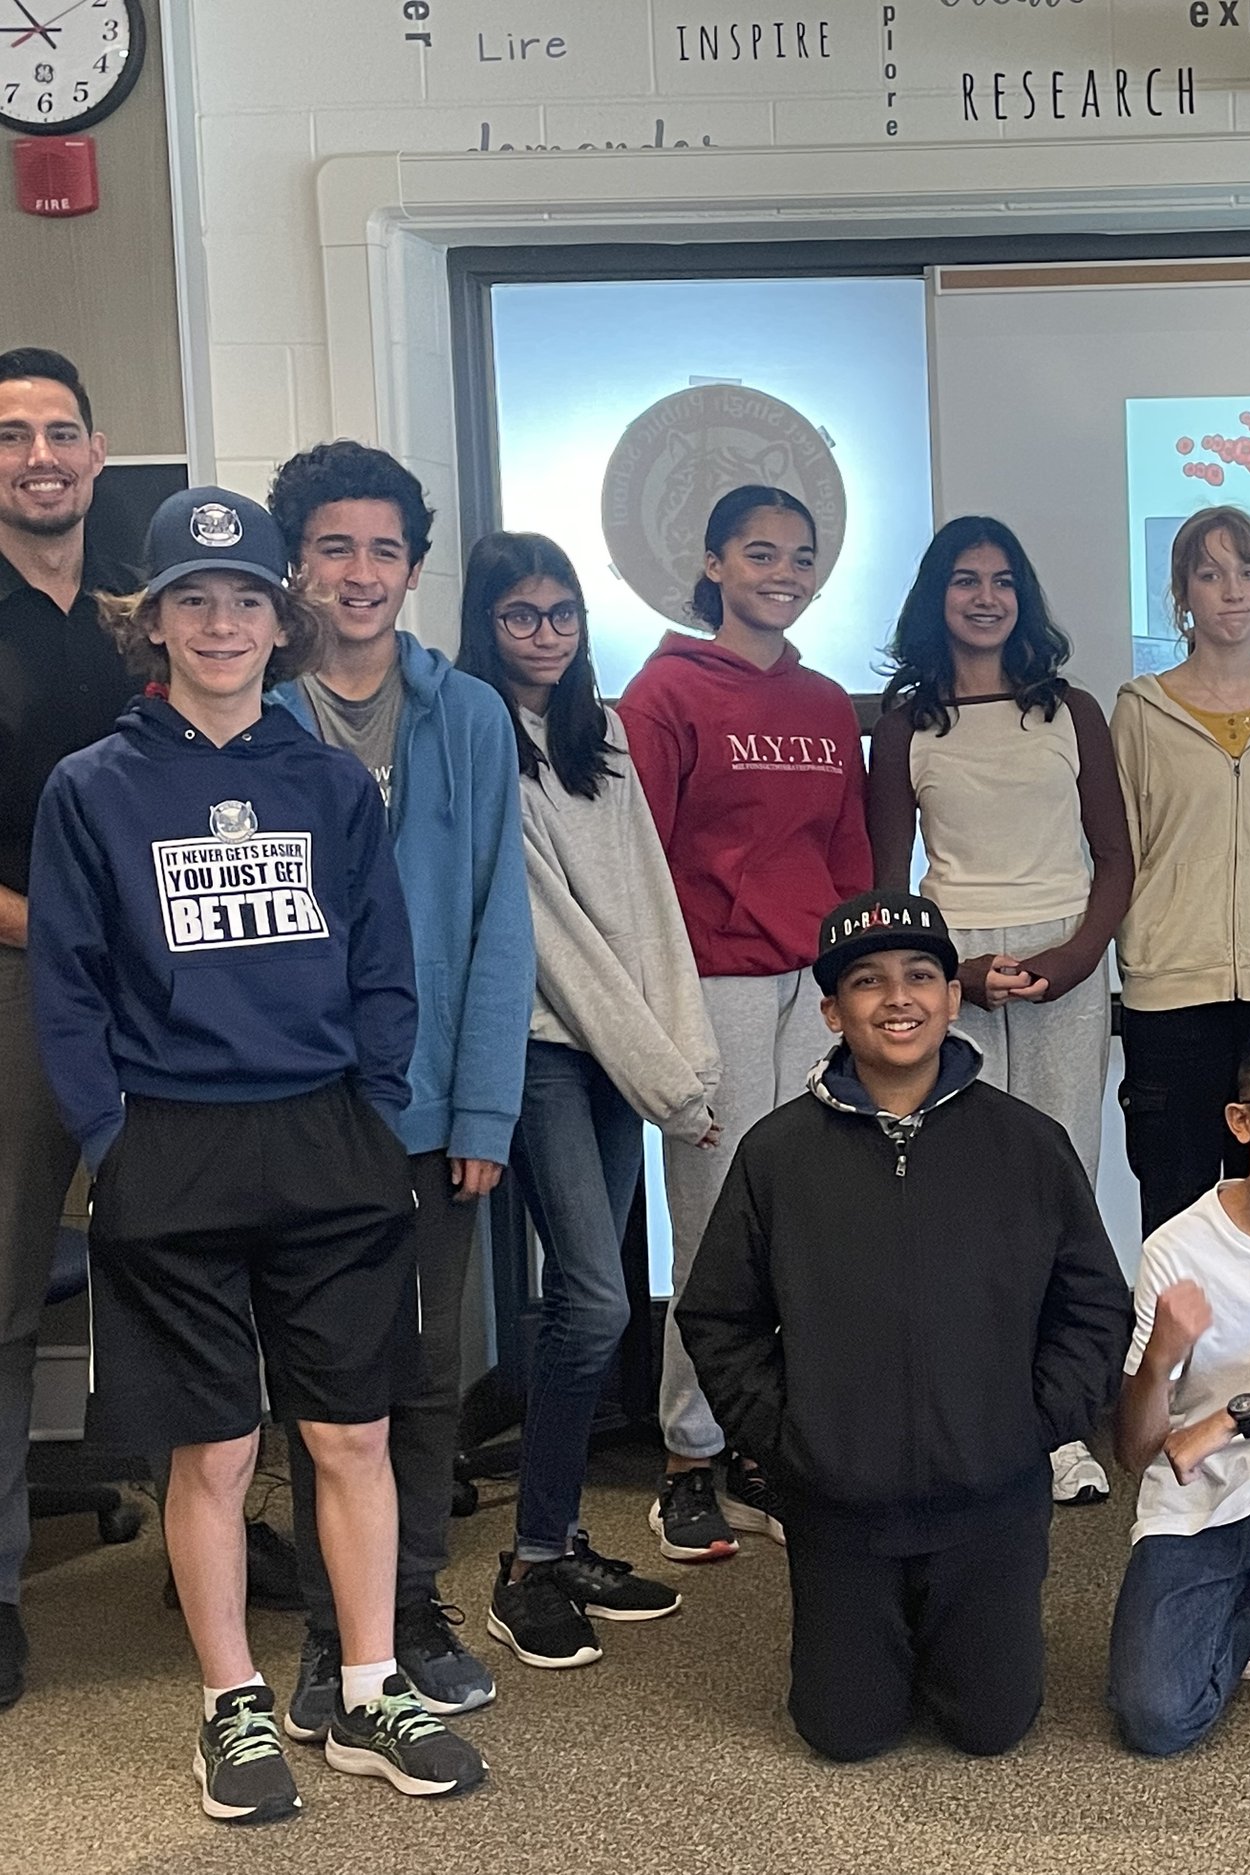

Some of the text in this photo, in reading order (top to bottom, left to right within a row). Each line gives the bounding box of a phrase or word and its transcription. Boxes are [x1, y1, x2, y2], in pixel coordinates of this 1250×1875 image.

[102, 20, 119, 41] 3
[677, 21, 831, 61] INSPIRE
[478, 32, 567, 61] Lire
[93, 53, 109, 73] 4
[883, 5, 898, 136] plore
[4, 83, 20, 104] 7
[37, 93, 53, 113] 6
[73, 81, 89, 102] 5
[962, 67, 1195, 121] RESEARCH
[36, 198, 70, 210] FIRE
[166, 852, 178, 866] IT
[182, 849, 223, 864] NEVER
[226, 846, 259, 861] GETS
[169, 861, 303, 892] YOU JUST GET
[170, 889, 322, 944] BETTER
[830, 908, 931, 944] JORDAN
